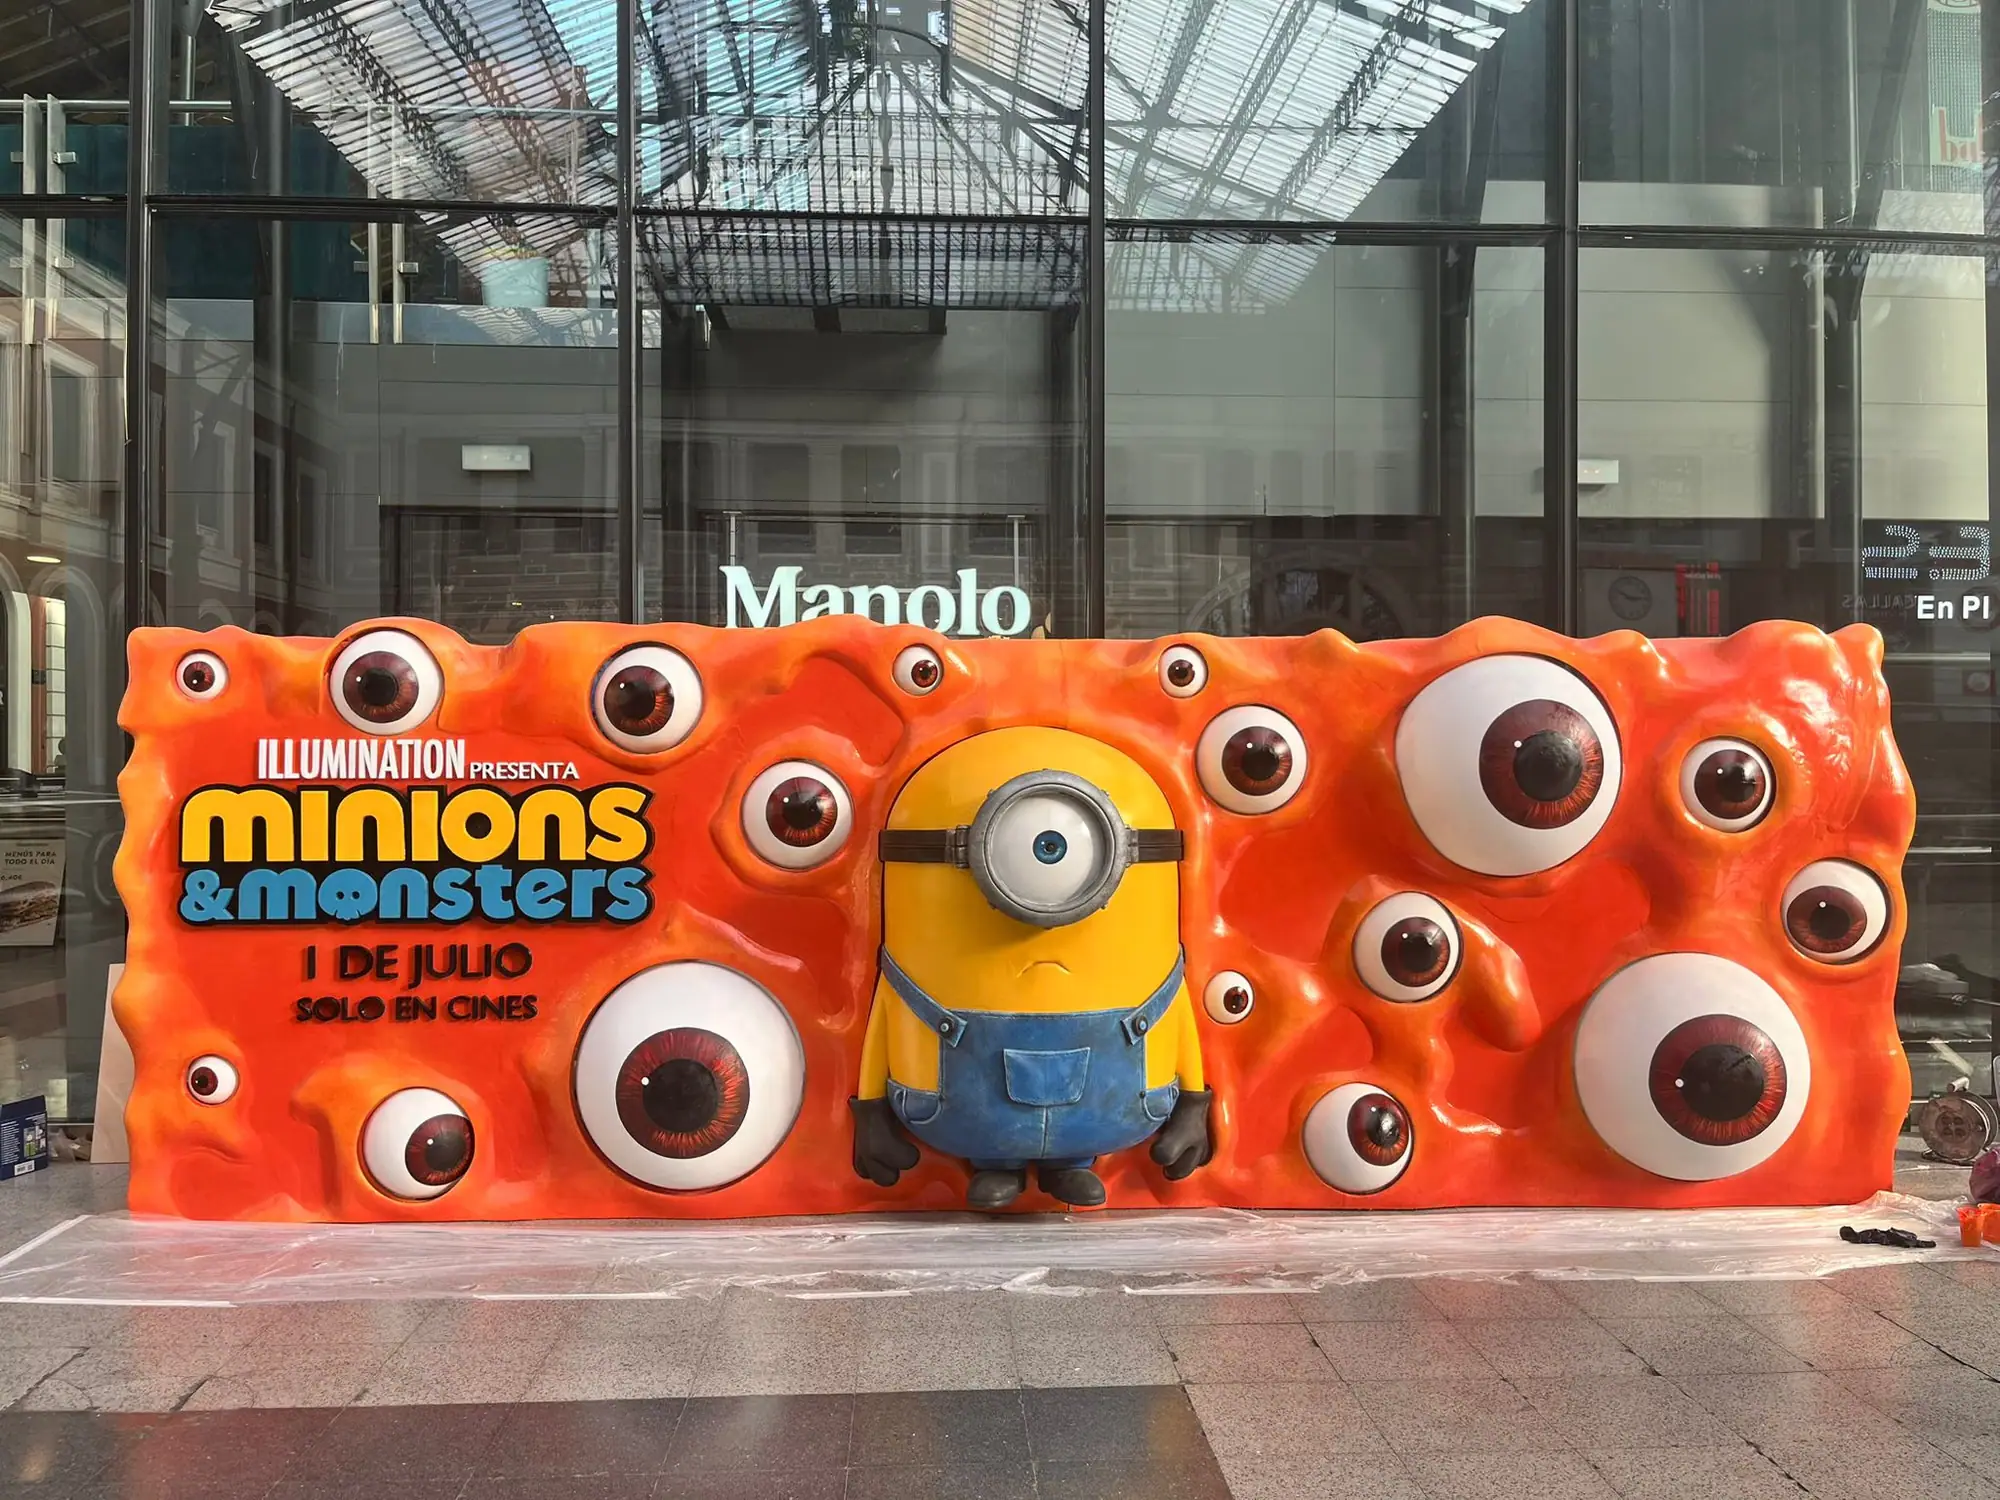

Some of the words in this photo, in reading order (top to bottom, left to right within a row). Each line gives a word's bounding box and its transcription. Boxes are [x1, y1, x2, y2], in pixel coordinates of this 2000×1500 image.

[719, 566, 1031, 635] Manolo
[1917, 595, 1953, 619] En
[257, 738, 466, 781] ILLUMINATION
[469, 761, 580, 781] PRESENTA
[339, 944, 399, 980] DE
[408, 942, 533, 990] JULIO
[296, 995, 386, 1022] SOLO
[395, 995, 437, 1021] EN
[447, 994, 538, 1021] CINES
